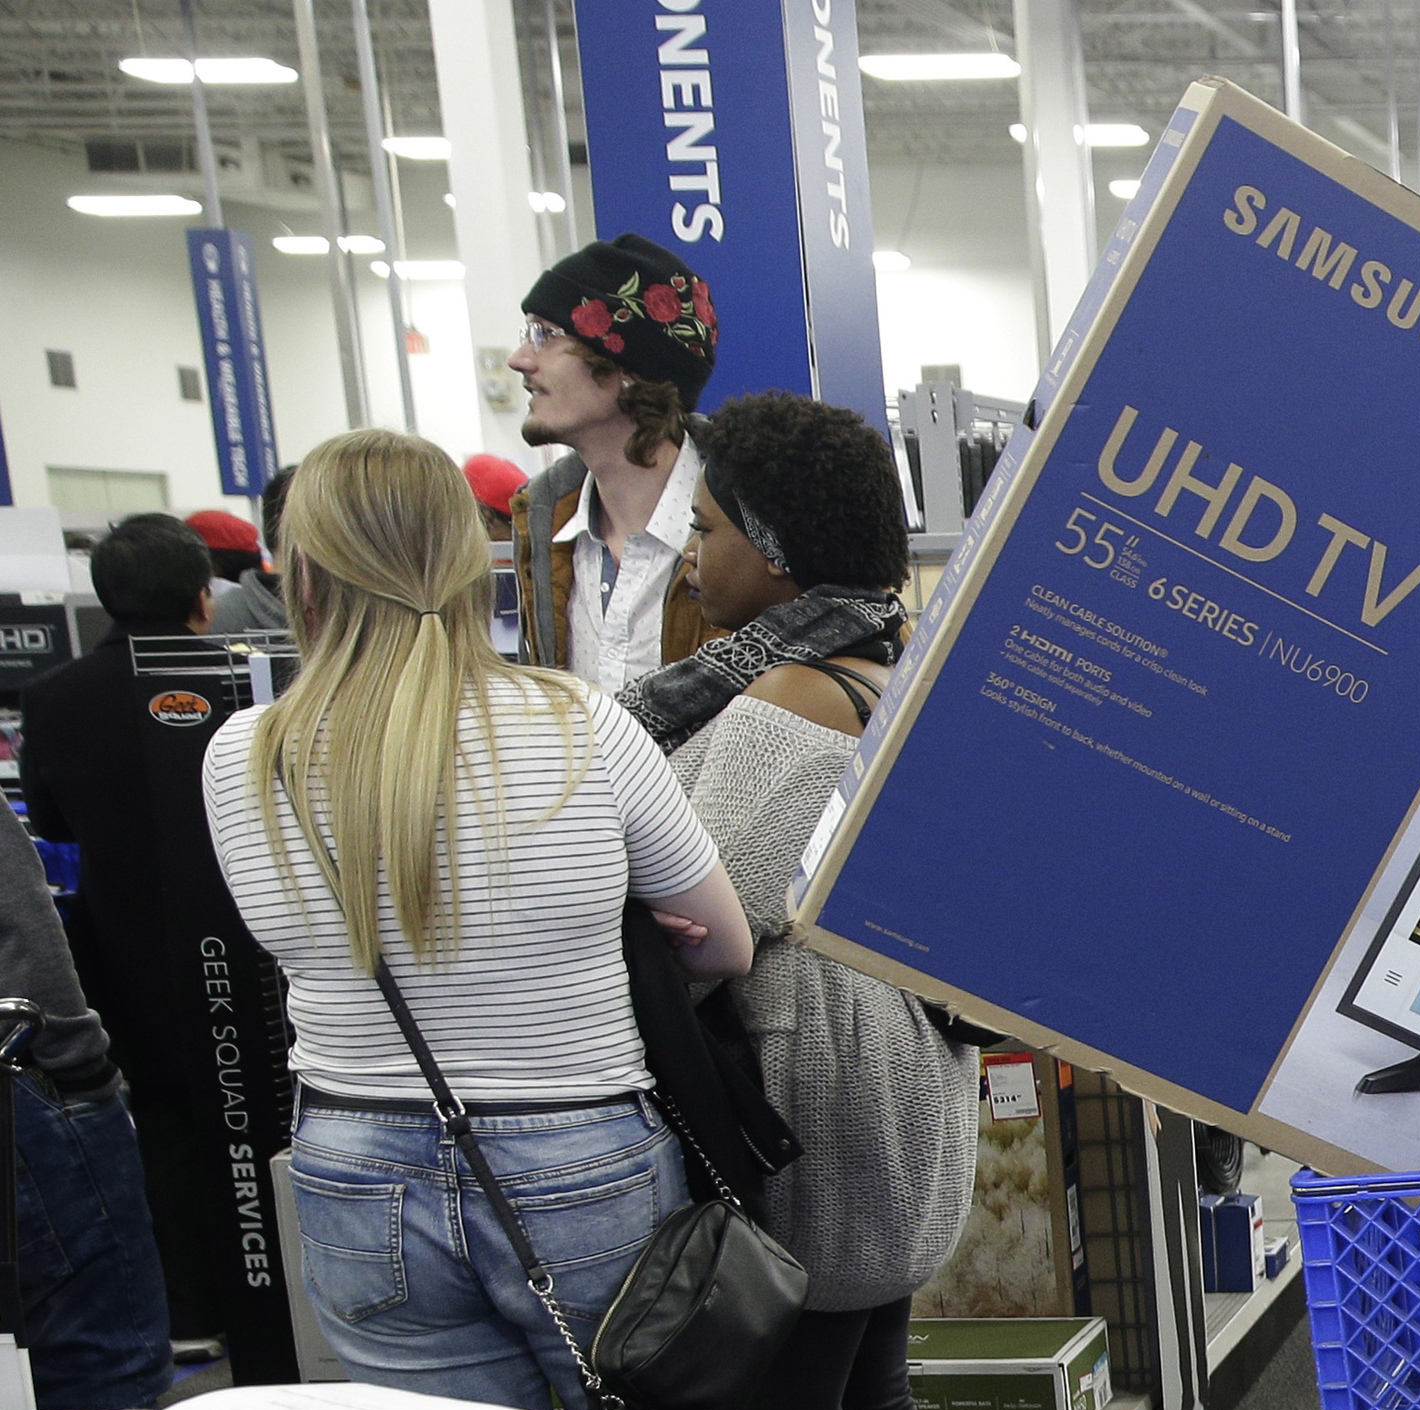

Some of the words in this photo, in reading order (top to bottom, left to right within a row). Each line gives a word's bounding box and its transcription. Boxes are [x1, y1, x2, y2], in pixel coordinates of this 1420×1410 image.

[654, 0, 725, 243] NENTS
[1097, 405, 1298, 565] UHD
[1031, 584, 1070, 611] CLEAN
[1069, 603, 1106, 629] CABLE
[1110, 569, 1140, 589] CLASS
[1076, 657, 1112, 682] PORTS
[1167, 584, 1259, 646] SERIES
[1269, 637, 1369, 703] NU6900
[1014, 685, 1057, 712] DESIGN
[200, 935, 237, 1014] GEEK
[212, 1025, 251, 1135] SQUAD
[228, 1143, 272, 1290] SERVICES
